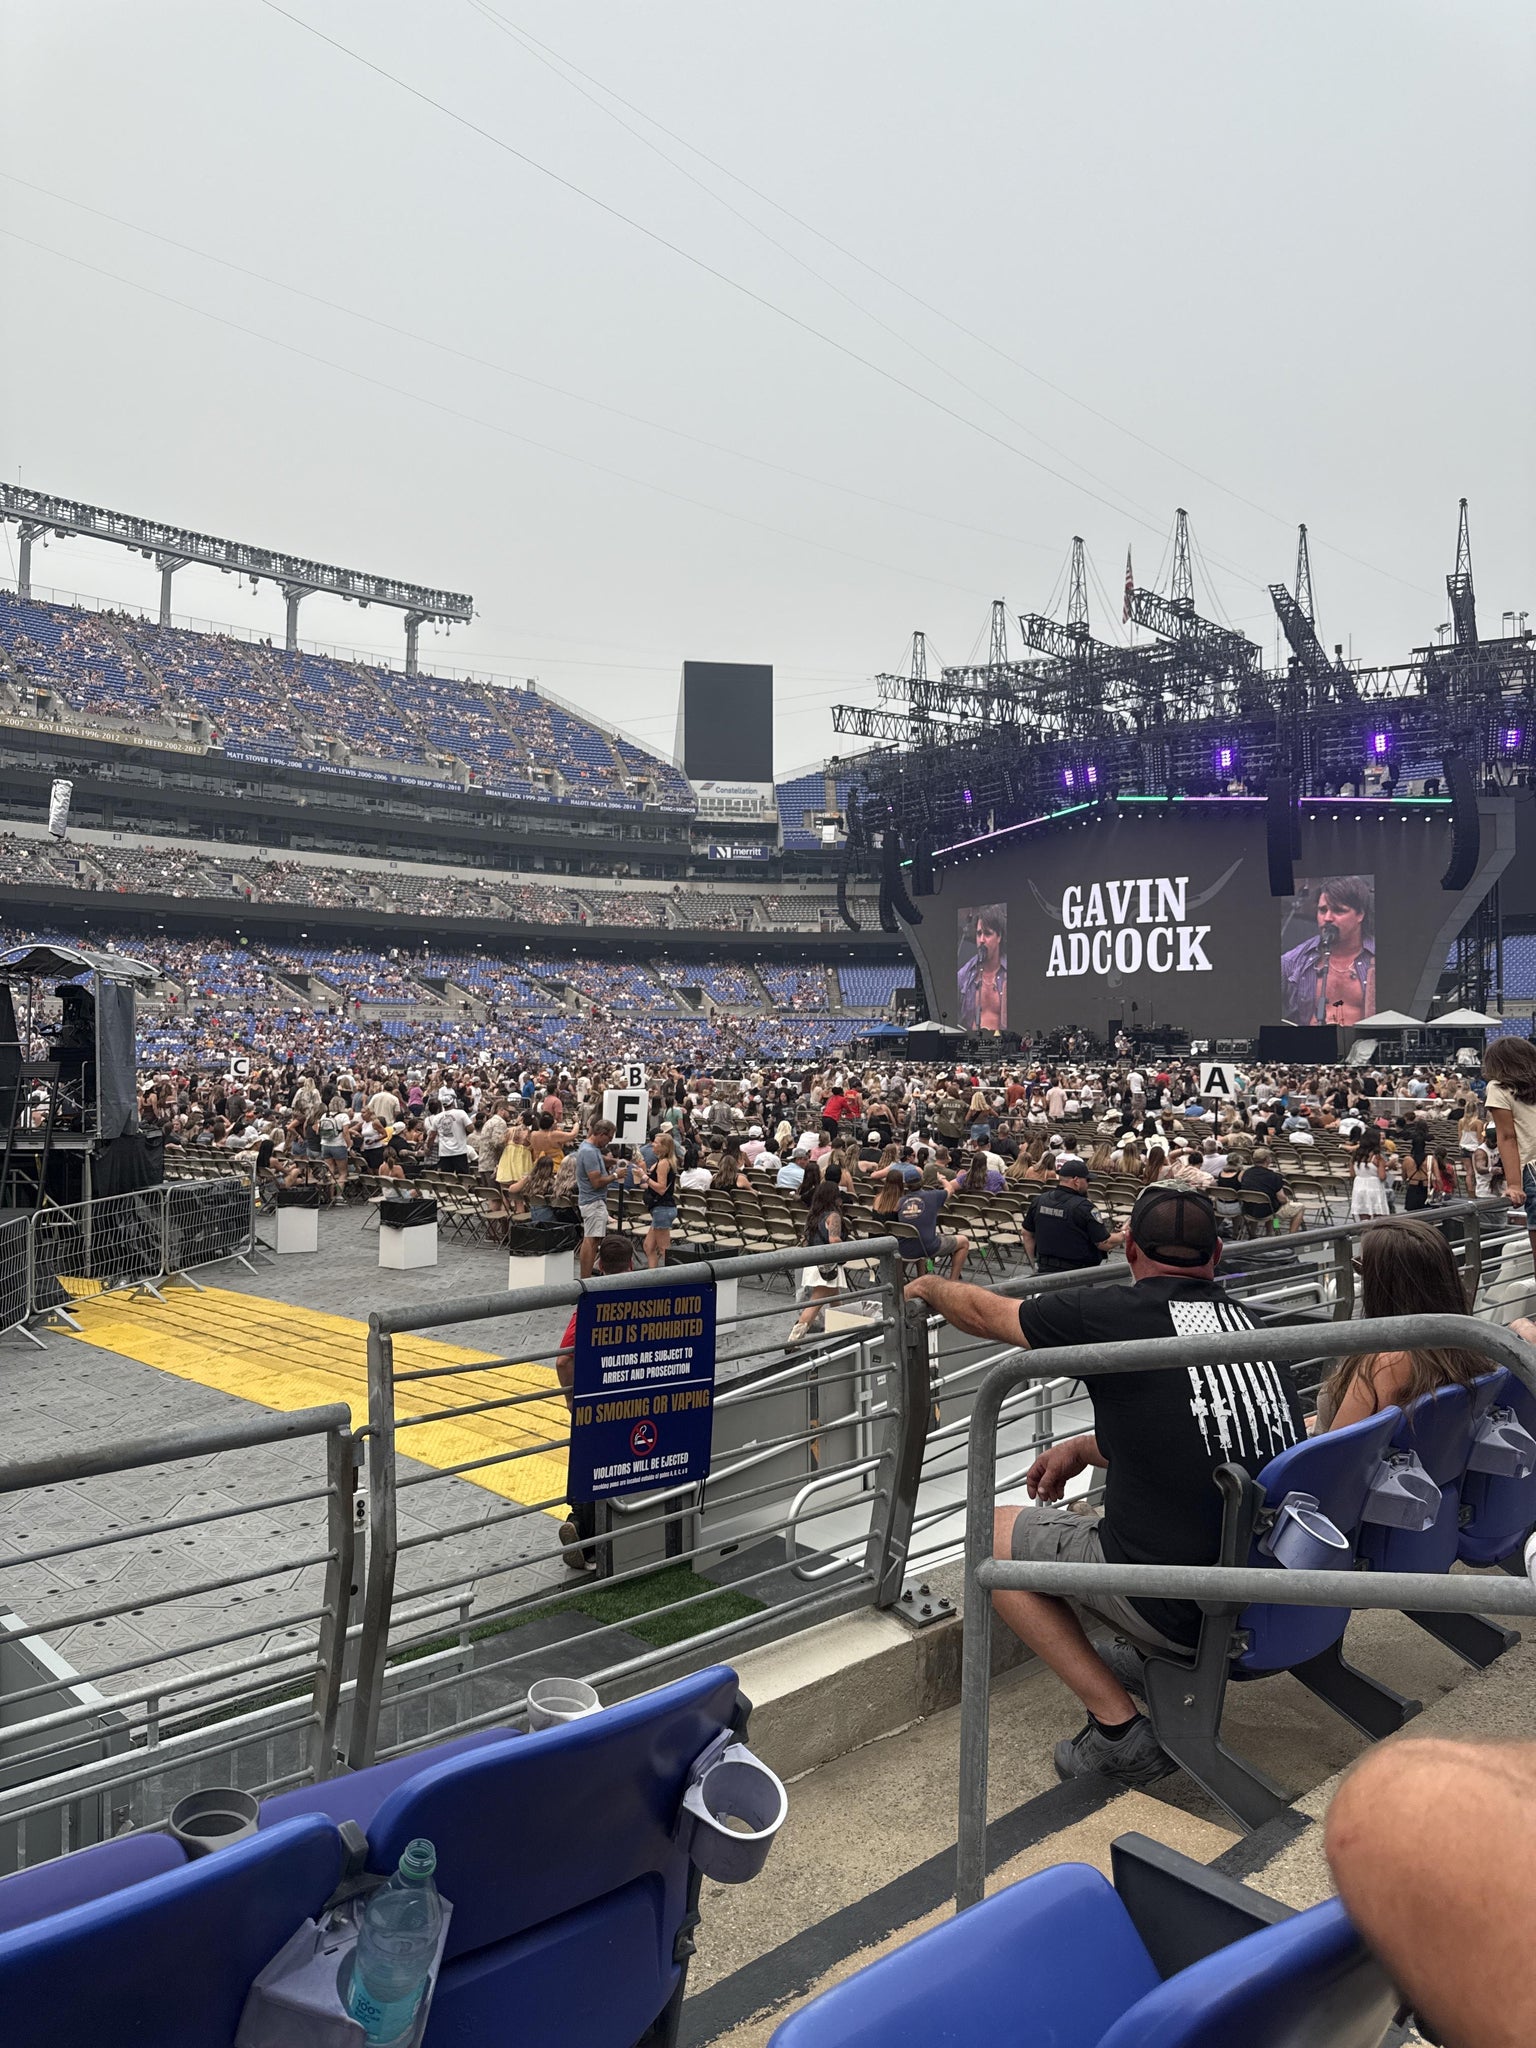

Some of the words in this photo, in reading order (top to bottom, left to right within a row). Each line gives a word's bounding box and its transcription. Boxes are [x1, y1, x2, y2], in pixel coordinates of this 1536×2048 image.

[39, 723, 54, 731] RAY
[56, 725, 79, 735] LEWIS
[82, 728, 120, 742] 1996-2012
[145, 739, 163, 748] REED
[165, 741, 201, 753] 2002-2012
[226, 751, 244, 760] MATT
[245, 754, 269, 764] STOVER
[270, 757, 303, 769] 1996-2008
[318, 765, 337, 774] JAMAL
[338, 768, 356, 776] LEWIS
[358, 770, 388, 781] 2000-2006
[433, 782, 461, 792] 2001-2010
[485, 789, 501, 797] BRIAN
[502, 791, 521, 800] BILLICK
[522, 794, 550, 803] 1999-2007
[716, 786, 758, 795] Constellation
[570, 799, 589, 807] HALOTI
[608, 802, 636, 810] 2006-2014
[733, 847, 762, 856] merritt
[1062, 877, 1189, 929] GAVIN
[1046, 925, 1213, 977] ADCOCK
[234, 1060, 246, 1074] C
[630, 1067, 641, 1087] B
[1204, 1066, 1230, 1094] A
[615, 1096, 640, 1138] F
[948, 1110, 957, 1124] 7
[596, 1298, 672, 1323] TRESPASSING
[674, 1296, 702, 1316] ONTO
[591, 1326, 623, 1347] FIELD
[626, 1324, 638, 1344] IS
[640, 1318, 703, 1342] PROHIBITED
[601, 1353, 639, 1369] VIOLATORS
[639, 1351, 653, 1364] ARE
[654, 1347, 684, 1362] SUBJECT
[684, 1346, 693, 1358] TO
[602, 1369, 629, 1385] ARREST
[630, 1368, 645, 1381] AND
[646, 1362, 691, 1379] PROSECUTION
[575, 1405, 592, 1427] NO
[595, 1397, 650, 1424] SMOKING
[653, 1395, 668, 1415] OR
[671, 1389, 710, 1412] VAPING
[593, 1462, 631, 1481] VIOLATORS
[632, 1459, 649, 1473] WILL
[650, 1457, 660, 1470] BE
[660, 1452, 689, 1468] EJECTED
